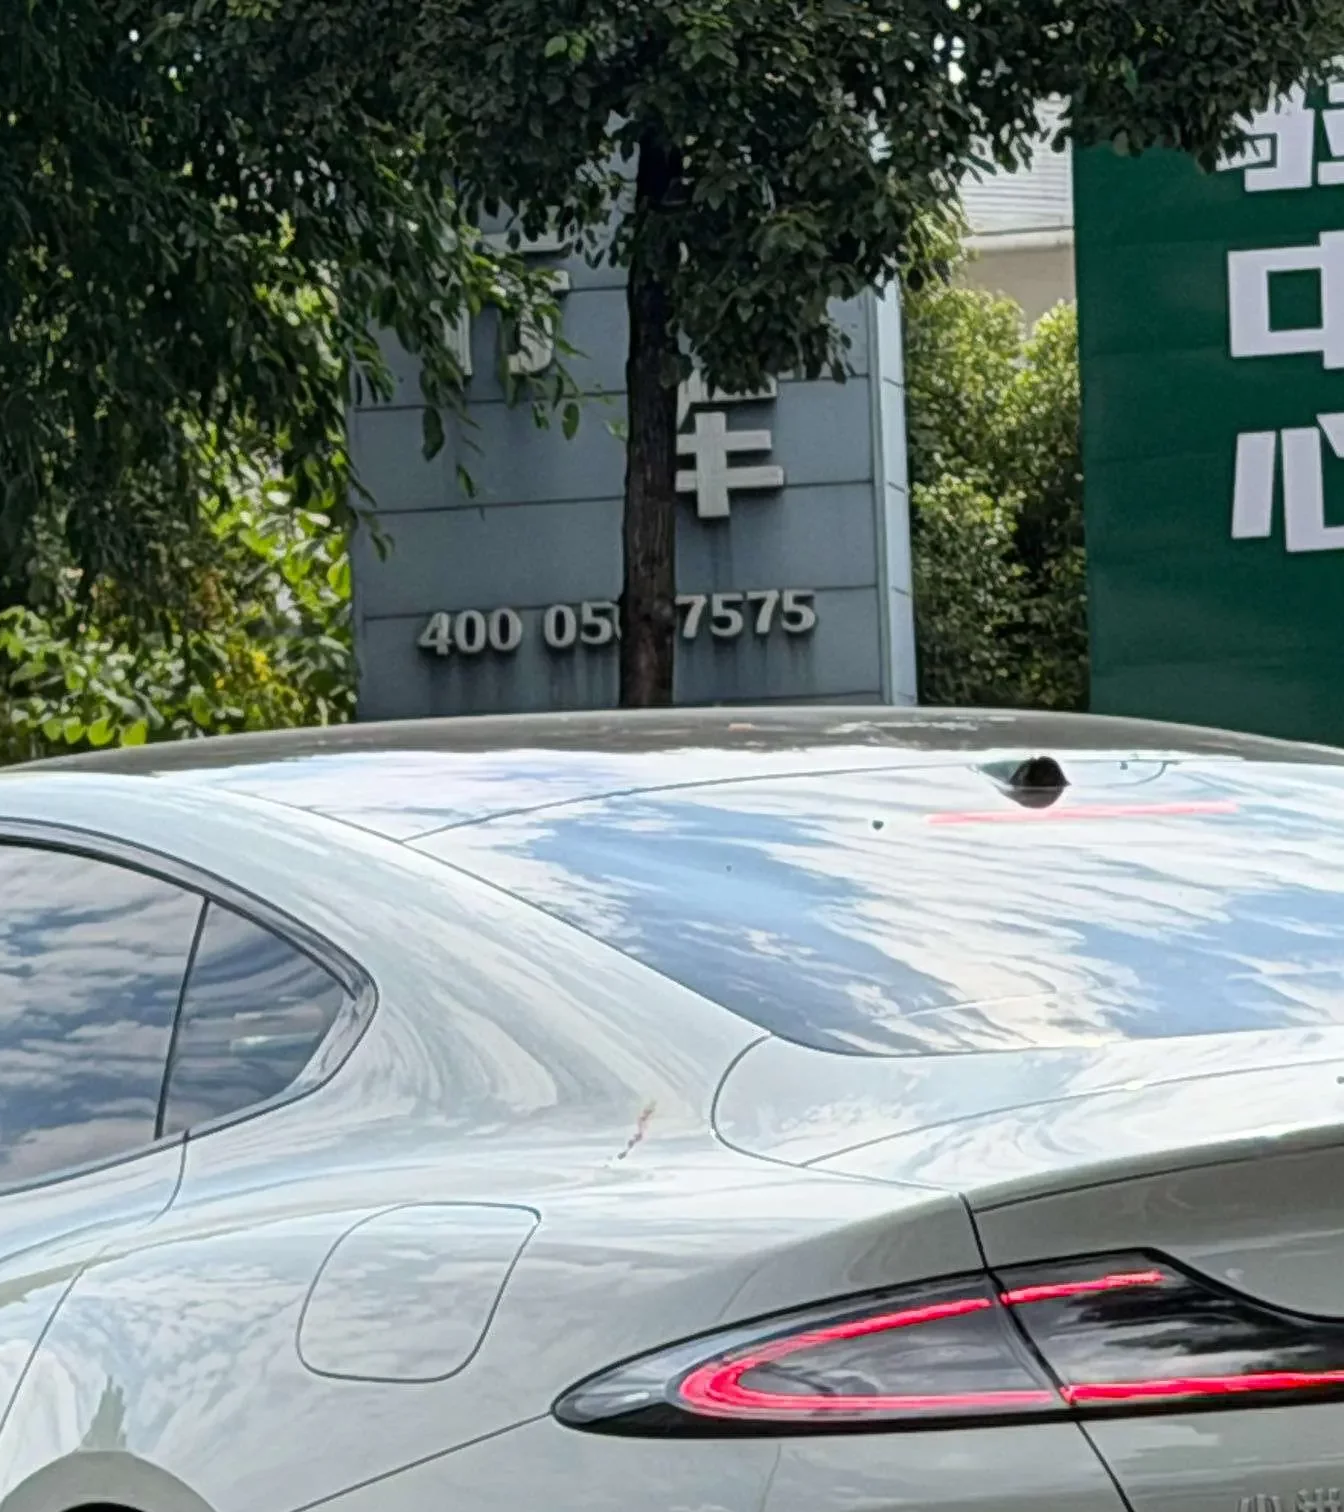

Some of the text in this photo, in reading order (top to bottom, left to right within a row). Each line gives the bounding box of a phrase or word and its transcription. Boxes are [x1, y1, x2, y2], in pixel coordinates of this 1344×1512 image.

[418, 589, 817, 655] 400 05 7575
